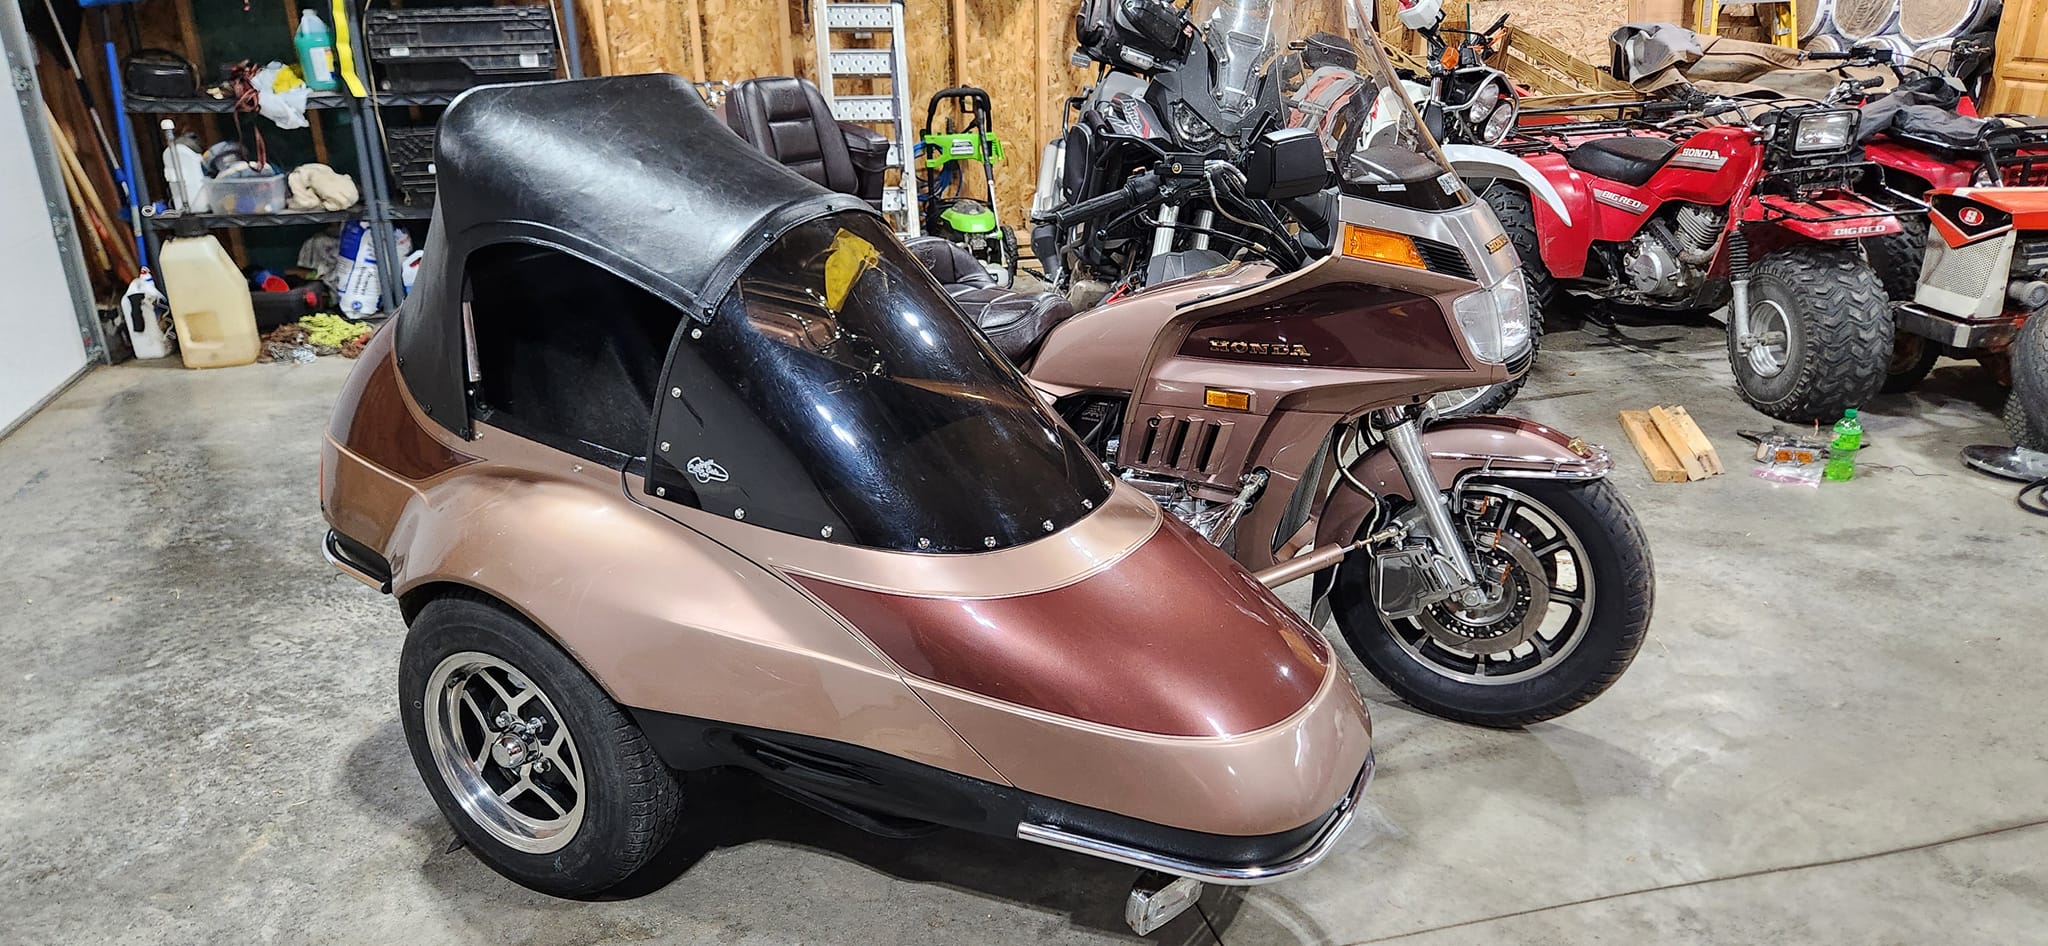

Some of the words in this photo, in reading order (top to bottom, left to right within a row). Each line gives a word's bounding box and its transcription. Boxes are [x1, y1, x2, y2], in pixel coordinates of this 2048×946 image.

[1683, 148, 1720, 159] HONDA
[1601, 190, 1620, 201] BIG
[1619, 196, 1642, 208] RED
[1834, 227, 1857, 235] BIG
[1857, 225, 1886, 234] RED
[1209, 340, 1311, 356] HONDA
